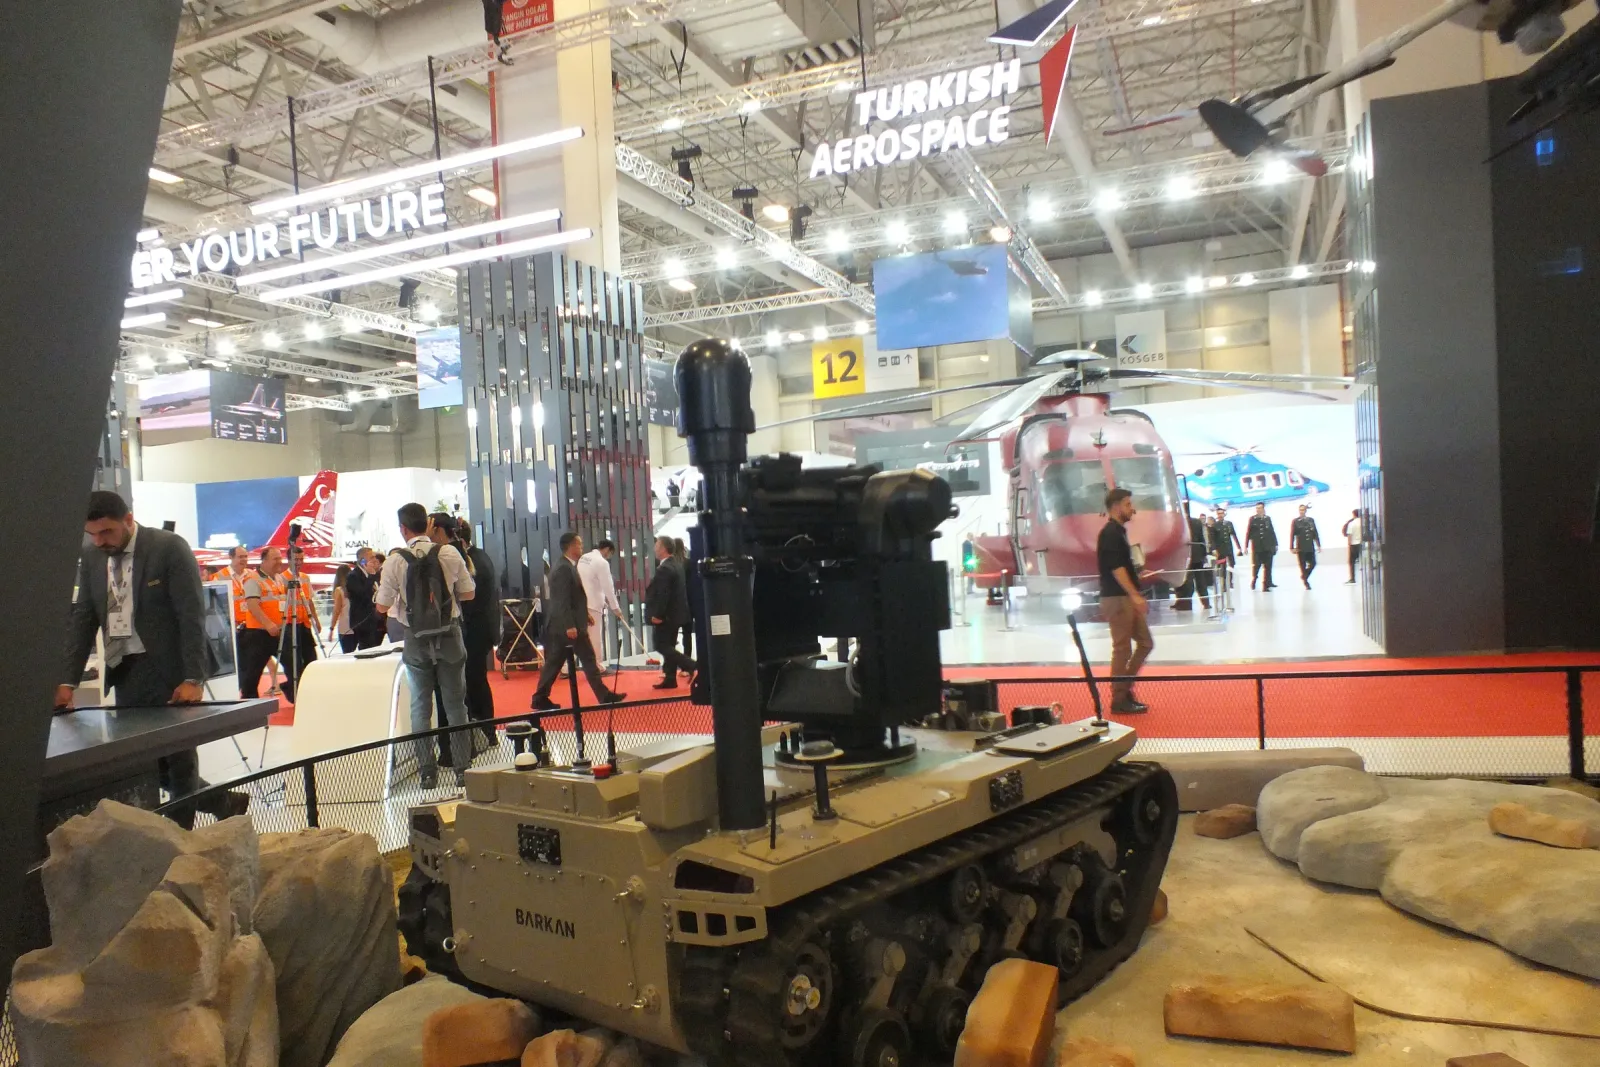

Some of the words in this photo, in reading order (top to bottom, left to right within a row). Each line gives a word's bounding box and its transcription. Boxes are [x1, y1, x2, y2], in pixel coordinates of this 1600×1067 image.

[855, 58, 1021, 126] TURKISH
[810, 105, 1011, 180] AEROSPACE
[180, 223, 281, 276] YOUR
[288, 183, 447, 255] FUTURE
[820, 349, 859, 385] 12
[1119, 352, 1165, 366] KOSGEB
[515, 908, 576, 940] BARKAN
